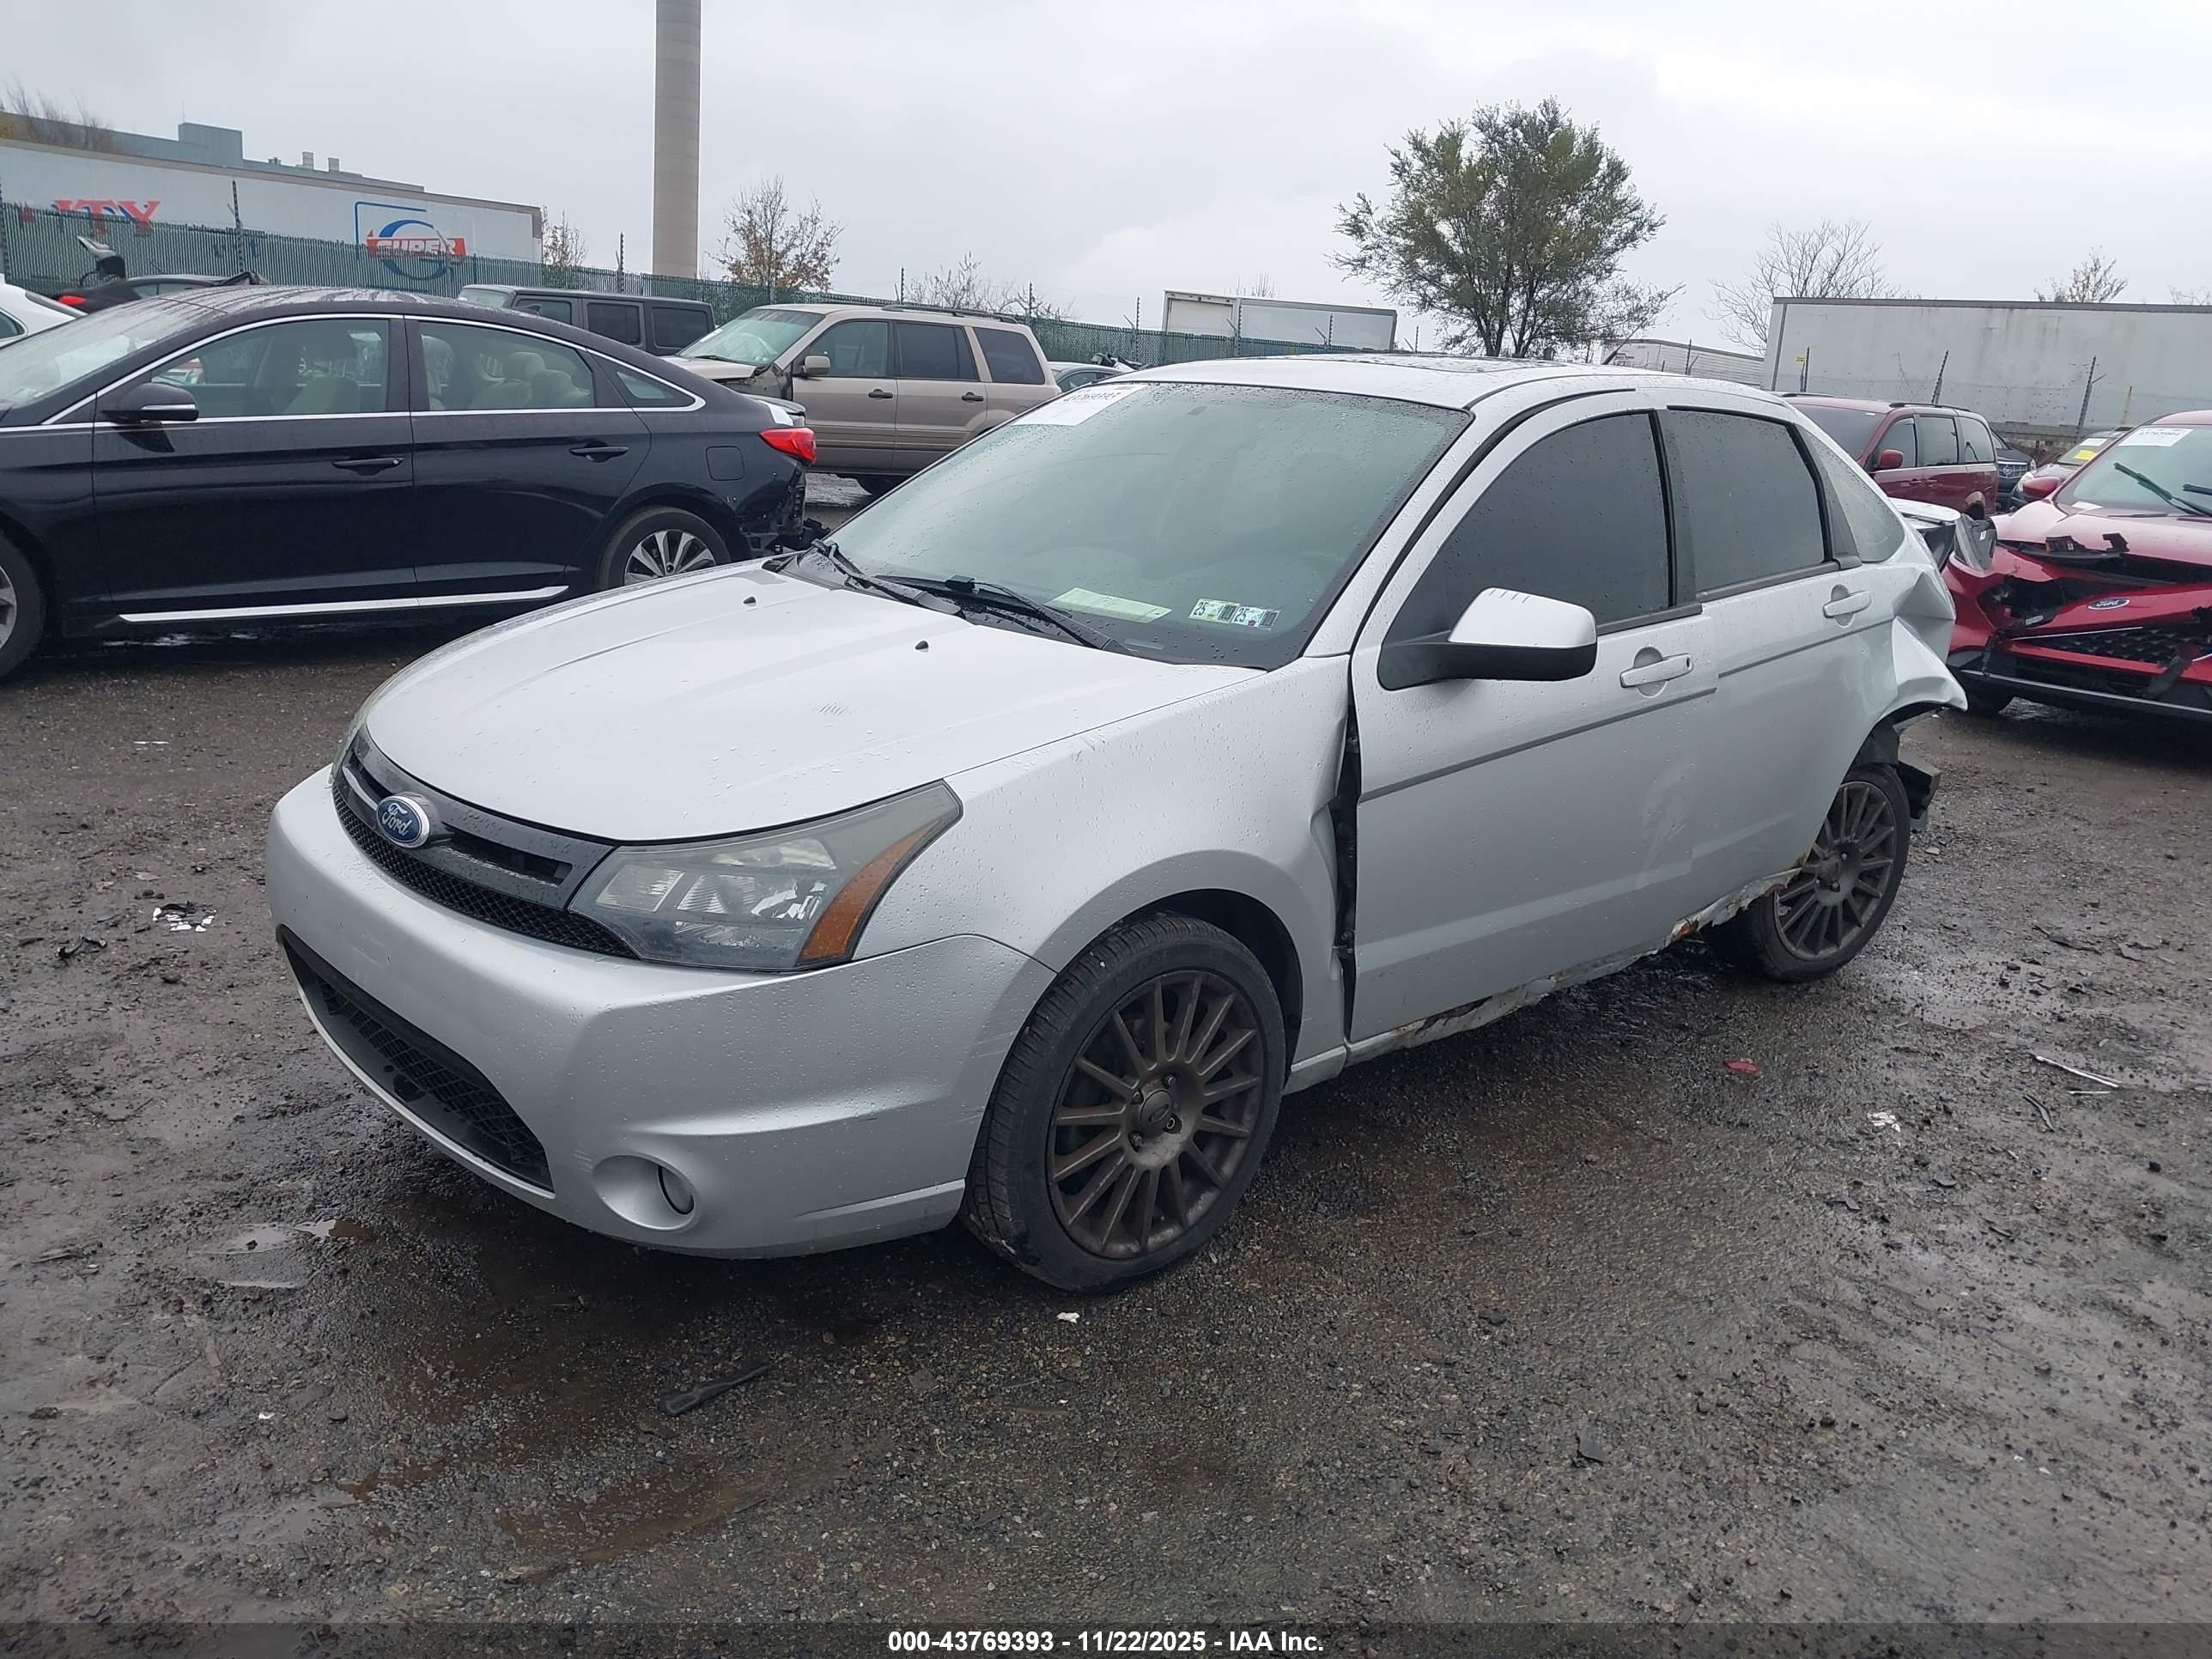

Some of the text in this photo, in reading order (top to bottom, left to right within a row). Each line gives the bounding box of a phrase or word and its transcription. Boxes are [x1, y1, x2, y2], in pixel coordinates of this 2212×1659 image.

[1194, 602, 1210, 617] 25
[1234, 607, 1250, 623] 25
[381, 802, 412, 836] Ford
